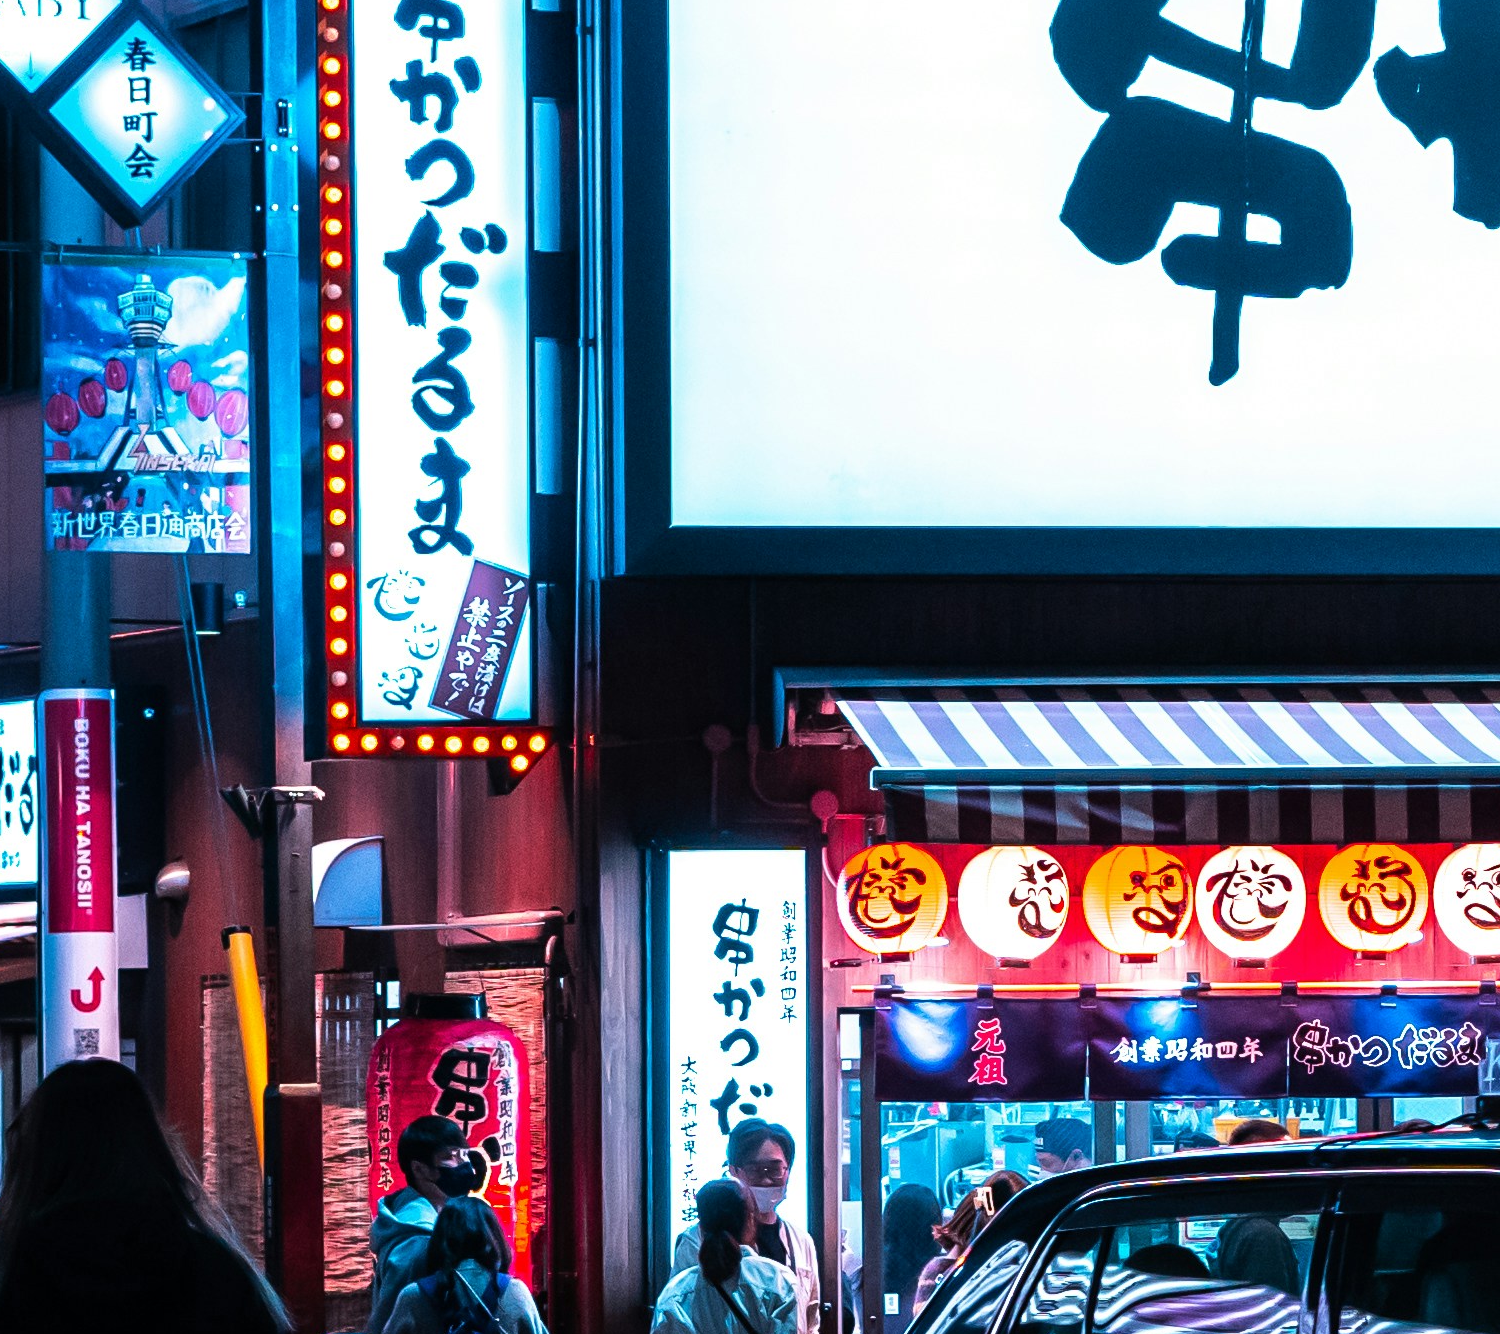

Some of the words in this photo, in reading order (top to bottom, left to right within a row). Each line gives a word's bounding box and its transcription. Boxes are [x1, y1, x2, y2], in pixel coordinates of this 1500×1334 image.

[122, 37, 159, 179] 春日町会
[52, 510, 247, 541] 新世界春日通商店会
[73, 718, 91, 779] BOKU
[75, 785, 91, 816] HA
[779, 900, 798, 1023] 創業昭和四年
[710, 898, 774, 1178] 串かつだ
[967, 1017, 1008, 1086] 元祖
[1109, 1036, 1265, 1065] 創業昭和四年
[1292, 1019, 1483, 1074] 串かつだるま
[492, 1040, 517, 1184] 創業昭和四年
